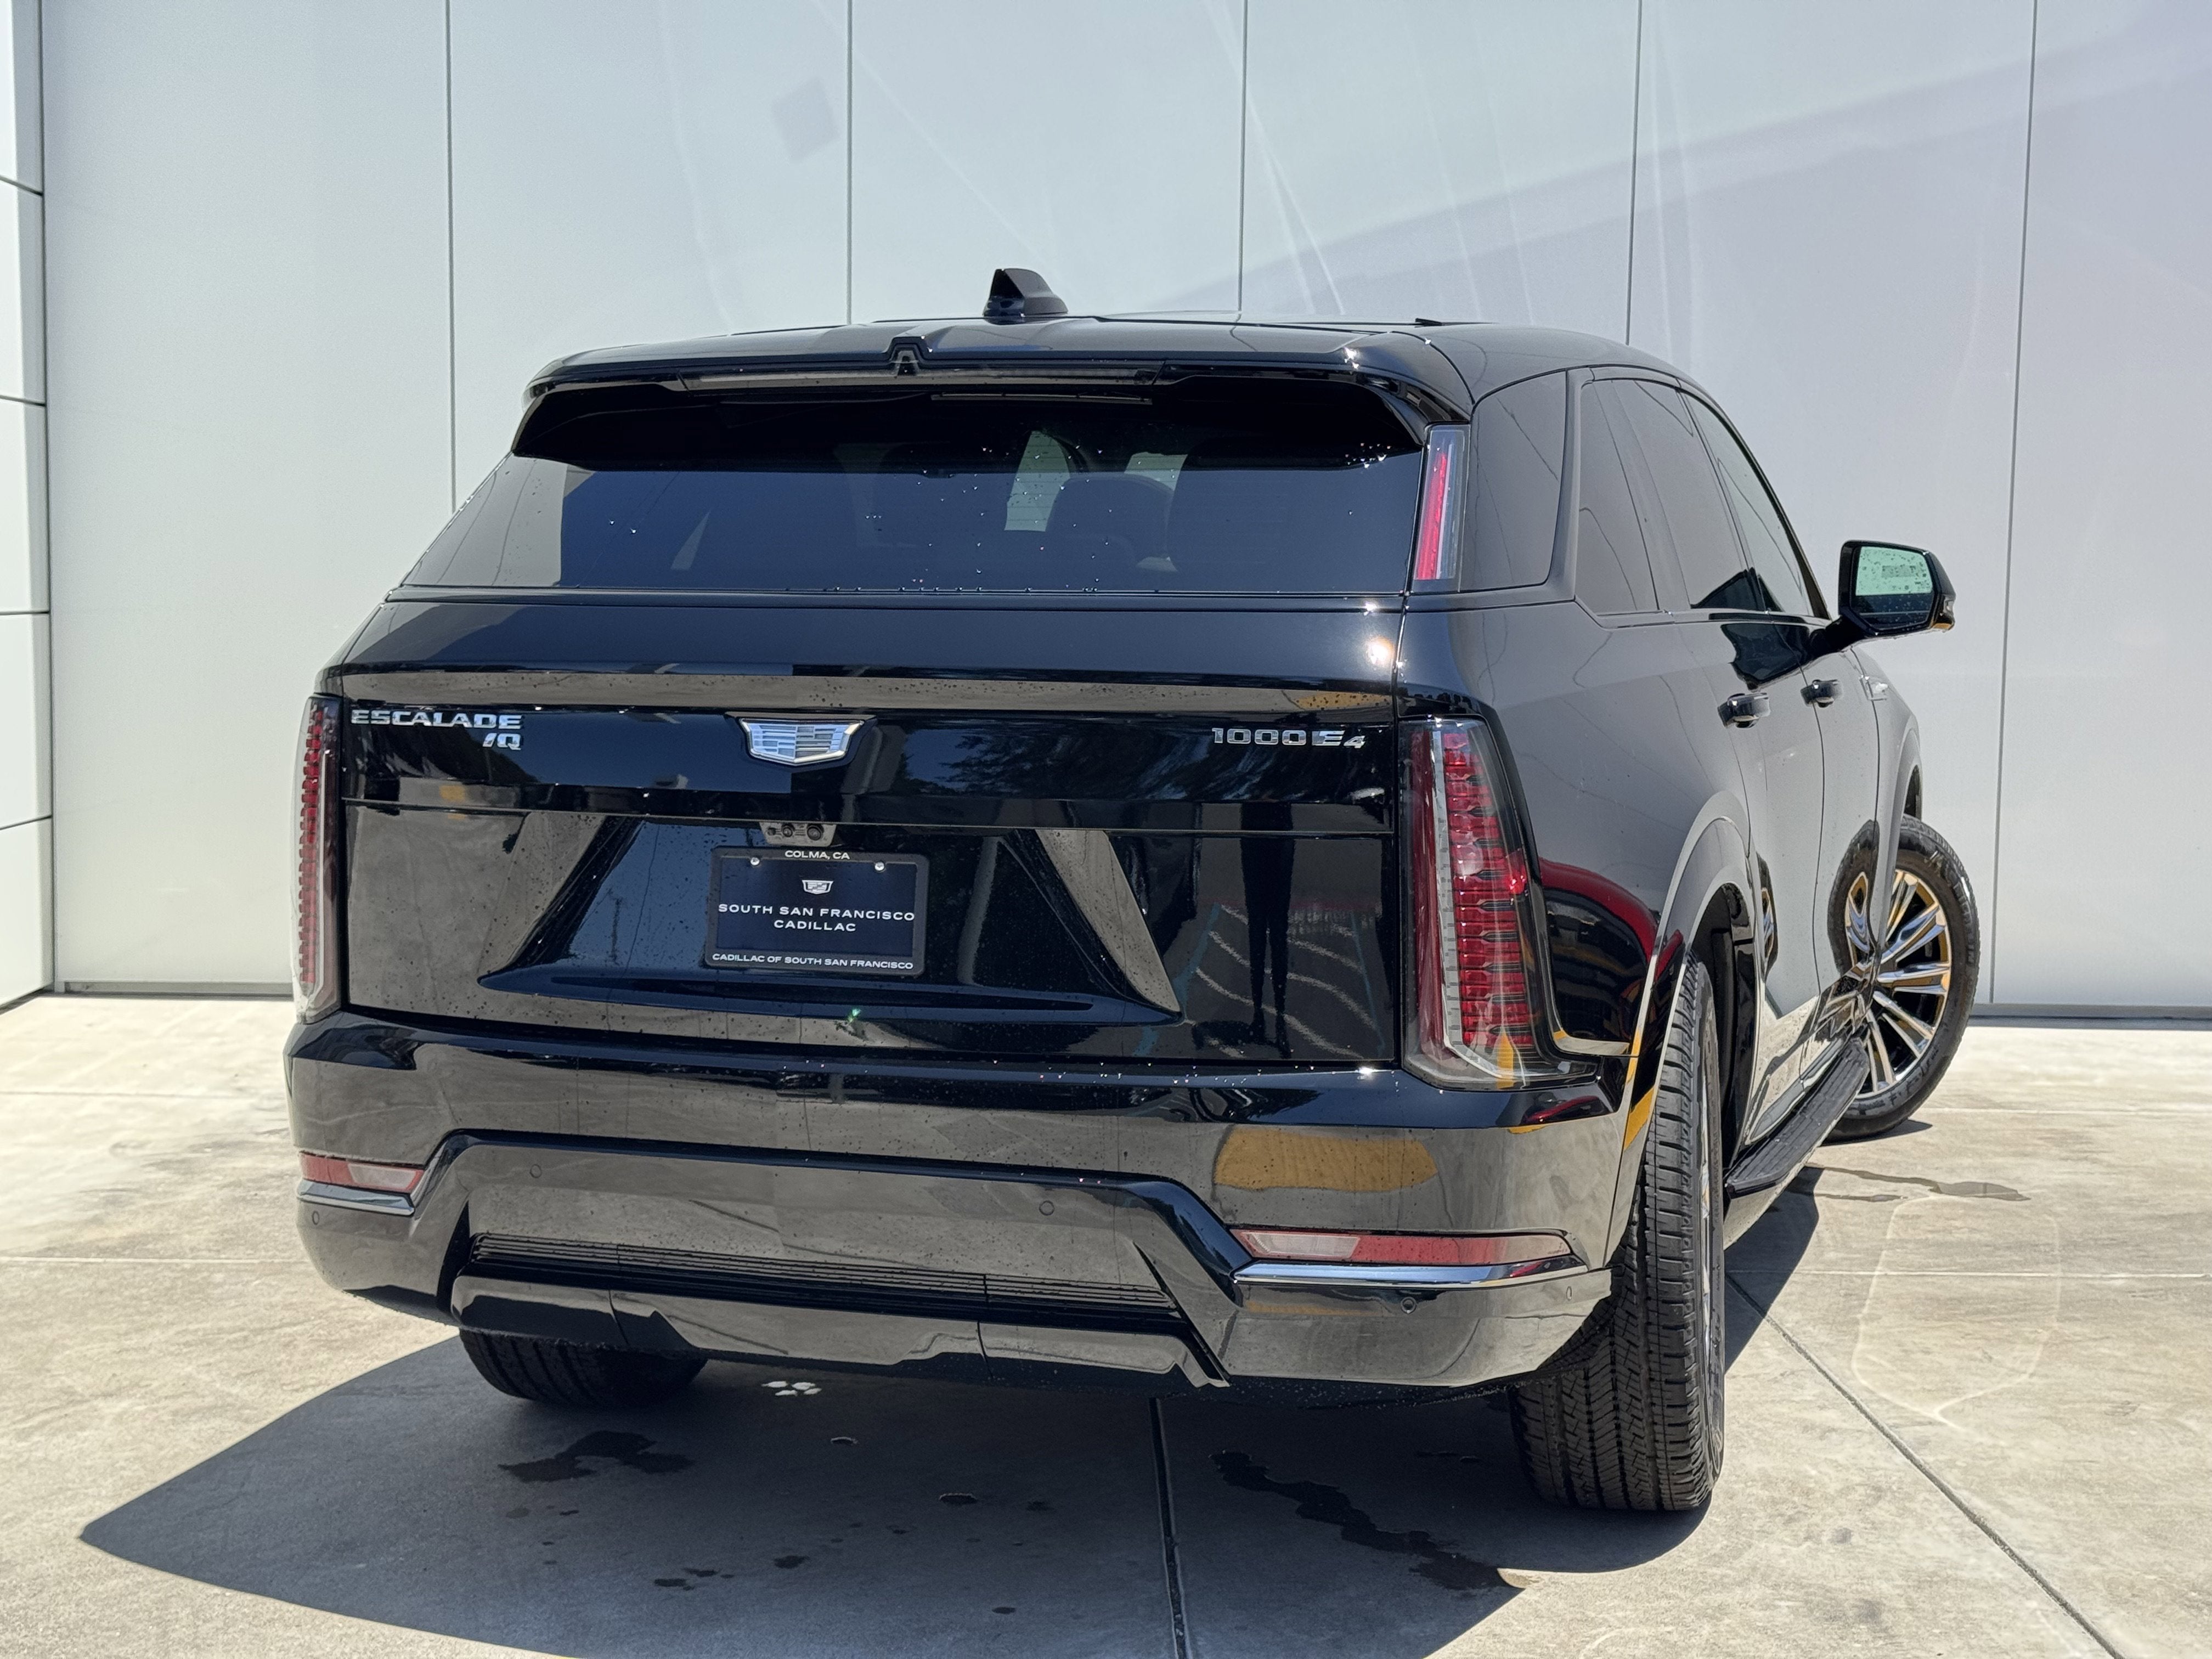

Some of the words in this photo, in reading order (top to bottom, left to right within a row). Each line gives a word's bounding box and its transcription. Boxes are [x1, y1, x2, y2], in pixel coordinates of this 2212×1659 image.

[351, 710, 521, 729] ESCALADE
[482, 733, 521, 751] IQ
[785, 850, 830, 860] COLMA,
[833, 851, 850, 860] CA
[718, 904, 772, 914] SOUTH
[780, 906, 813, 916] SAN
[820, 909, 915, 921] FRANCISCO
[774, 919, 856, 932] CADILLAC
[712, 953, 765, 963] CADILLAC
[784, 956, 822, 966] SOUTH
[824, 958, 848, 967] SAN
[850, 960, 914, 970] FRANCISCO
